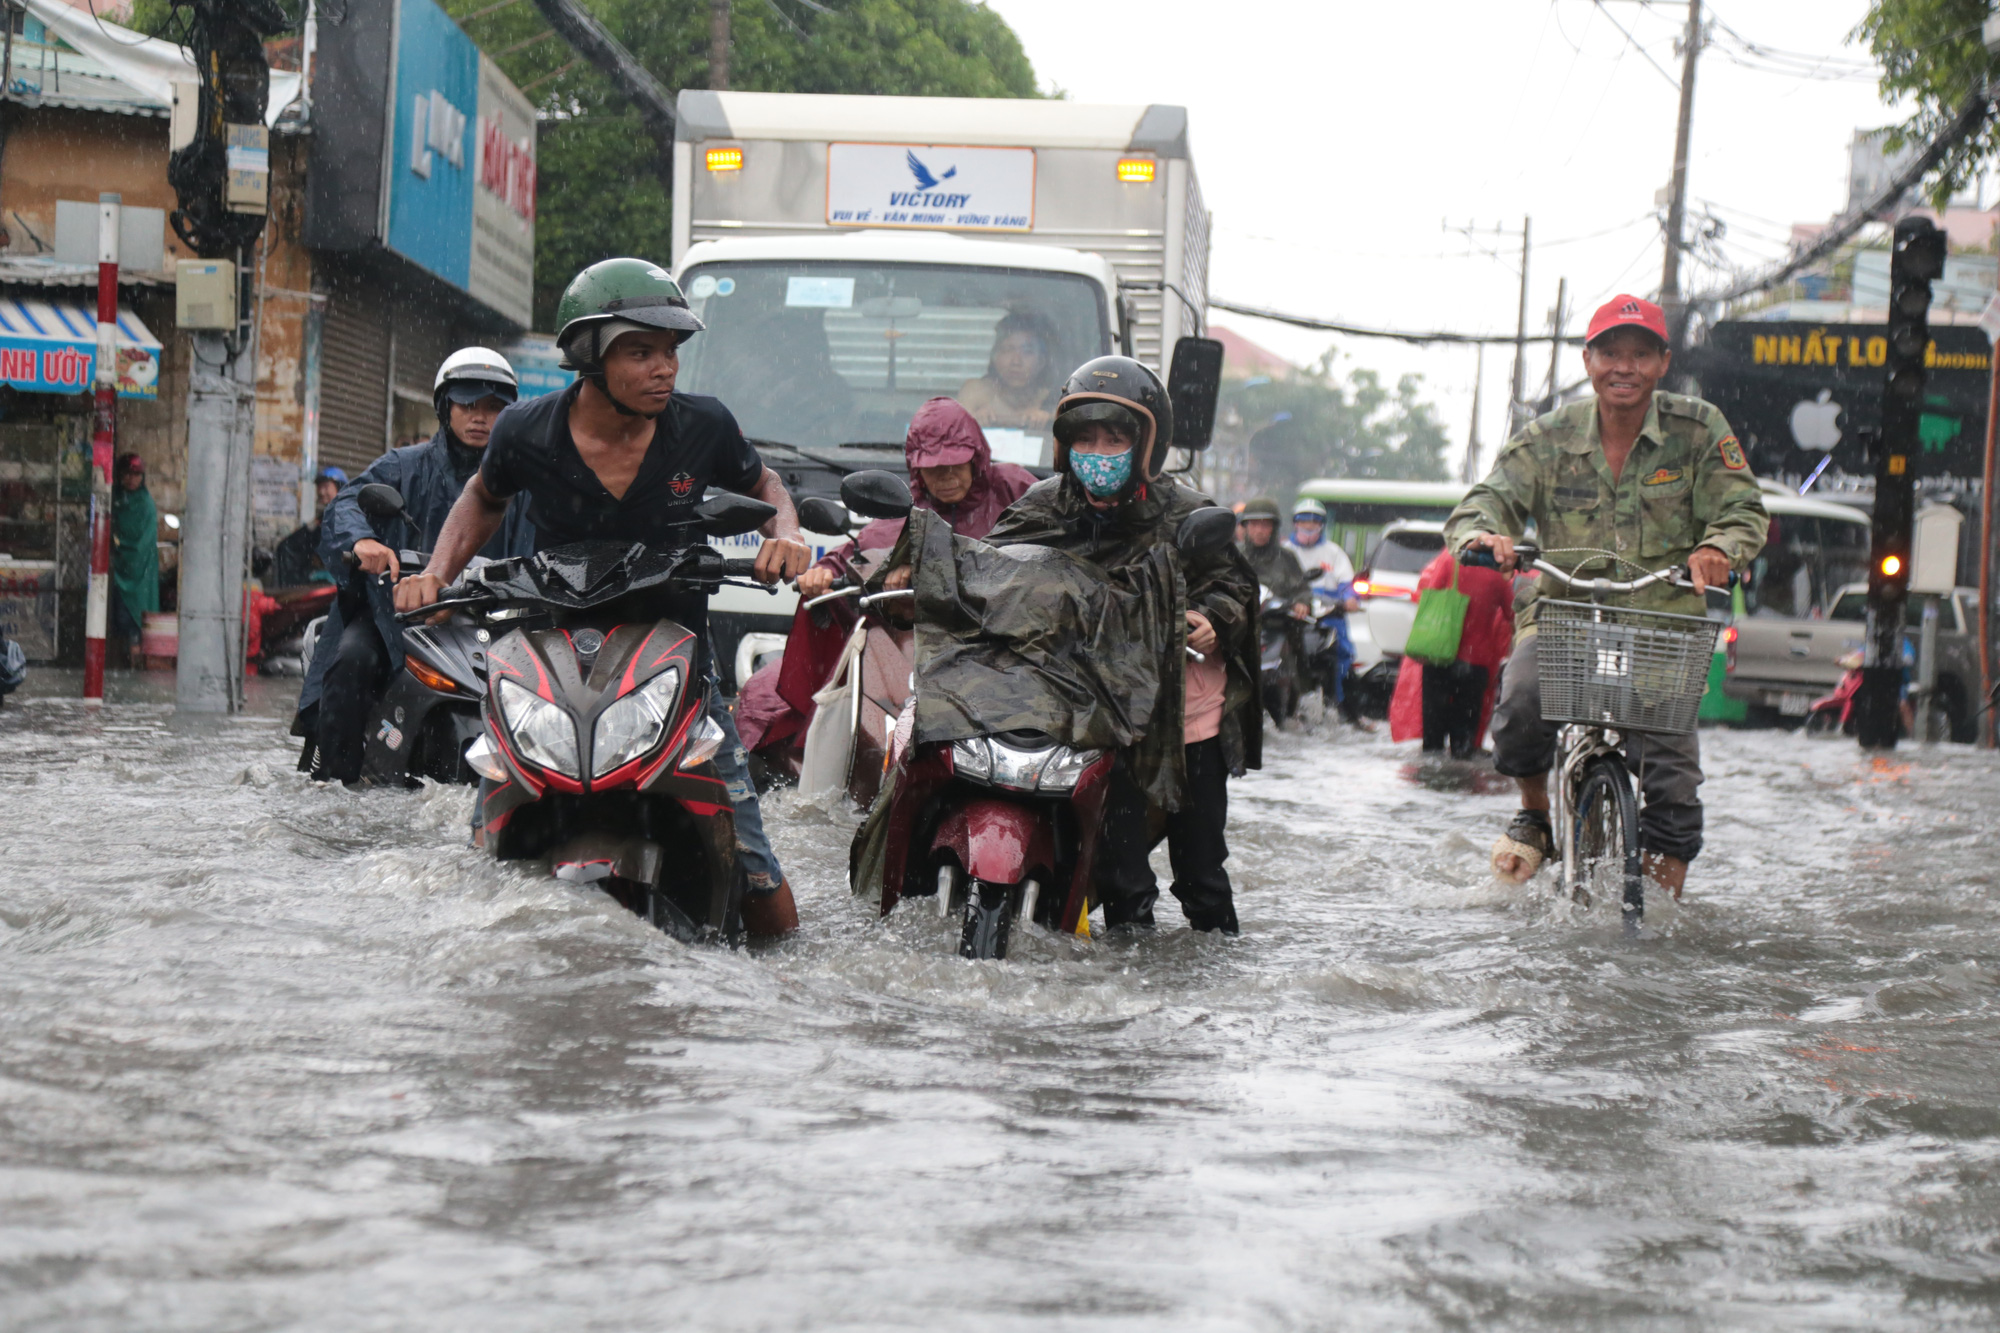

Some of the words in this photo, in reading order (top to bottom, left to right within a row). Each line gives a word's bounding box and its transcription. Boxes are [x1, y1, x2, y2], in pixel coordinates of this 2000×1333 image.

[889, 191, 971, 208] VICTORY
[832, 210, 852, 221] VUI
[911, 212, 945, 224] MINH
[43, 346, 92, 386] ƯỚT
